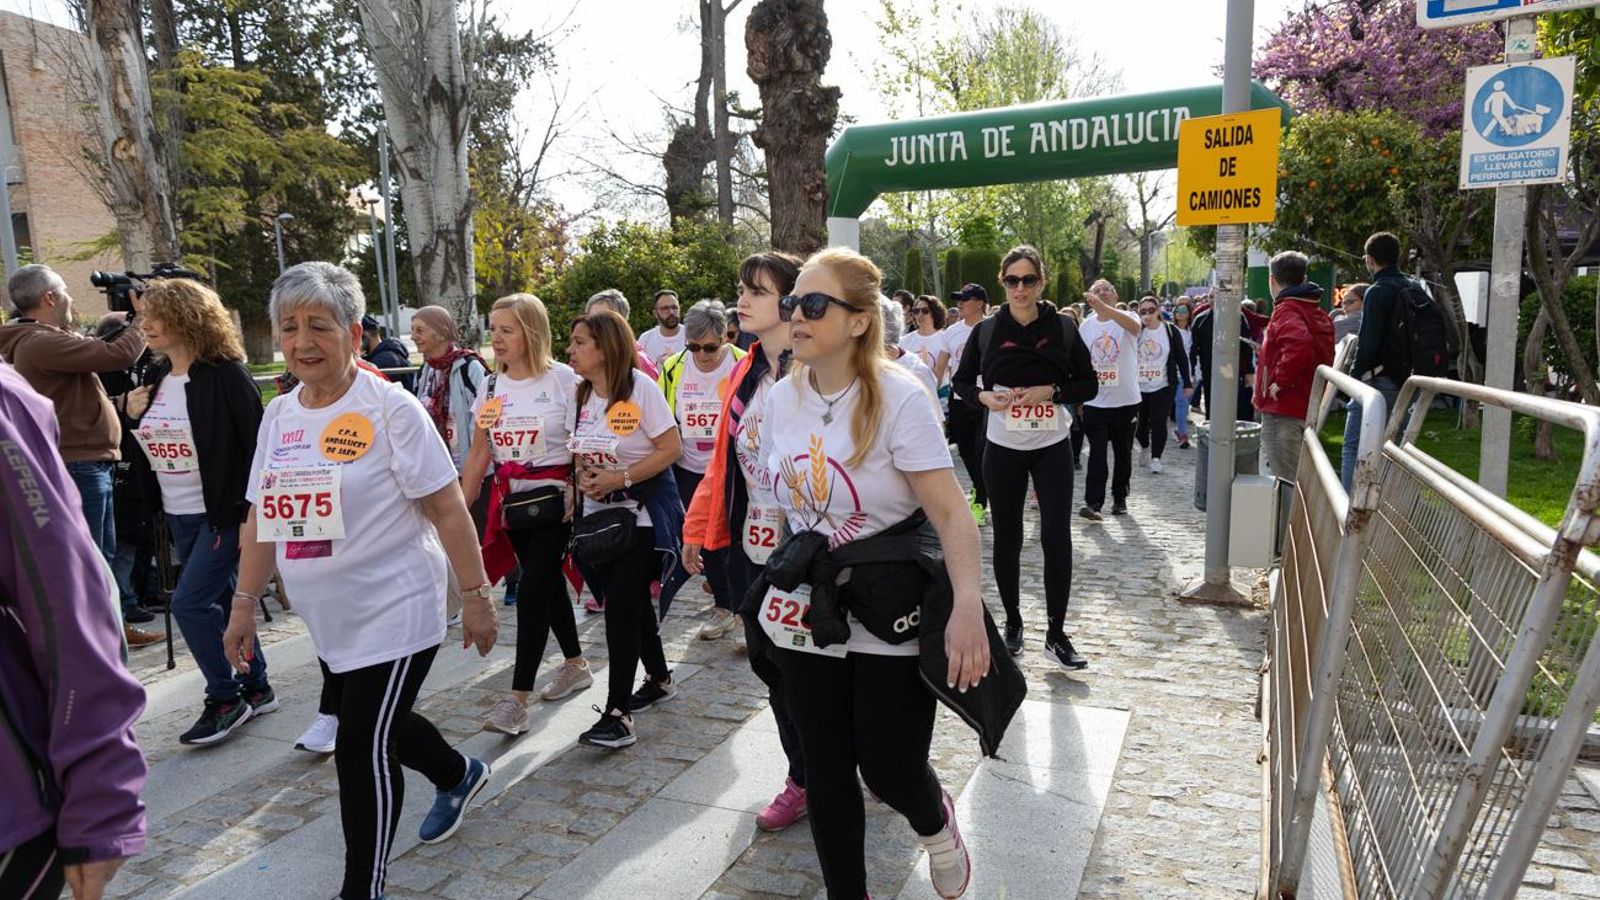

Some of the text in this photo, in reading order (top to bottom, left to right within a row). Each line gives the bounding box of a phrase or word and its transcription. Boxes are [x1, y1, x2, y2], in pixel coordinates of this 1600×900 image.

[1205, 123, 1254, 150] SALIDA
[884, 131, 968, 167] JUNTA
[981, 125, 1016, 158] DE
[1474, 149, 1556, 163] ES OBLIGATORIO
[1219, 157, 1237, 177] DE
[1484, 159, 1544, 171] LLEVAR LOS
[1470, 168, 1556, 182] PERROS SUJETOS
[1189, 187, 1261, 211] CAMIONES
[1011, 404, 1055, 419] 5705
[687, 413, 720, 428] 567
[324, 436, 368, 449] ANDALUCES
[493, 429, 540, 447] 5677
[147, 442, 193, 459] 5656
[326, 446, 336, 454] DE
[263, 492, 333, 520] 5675
[748, 524, 777, 548] 52
